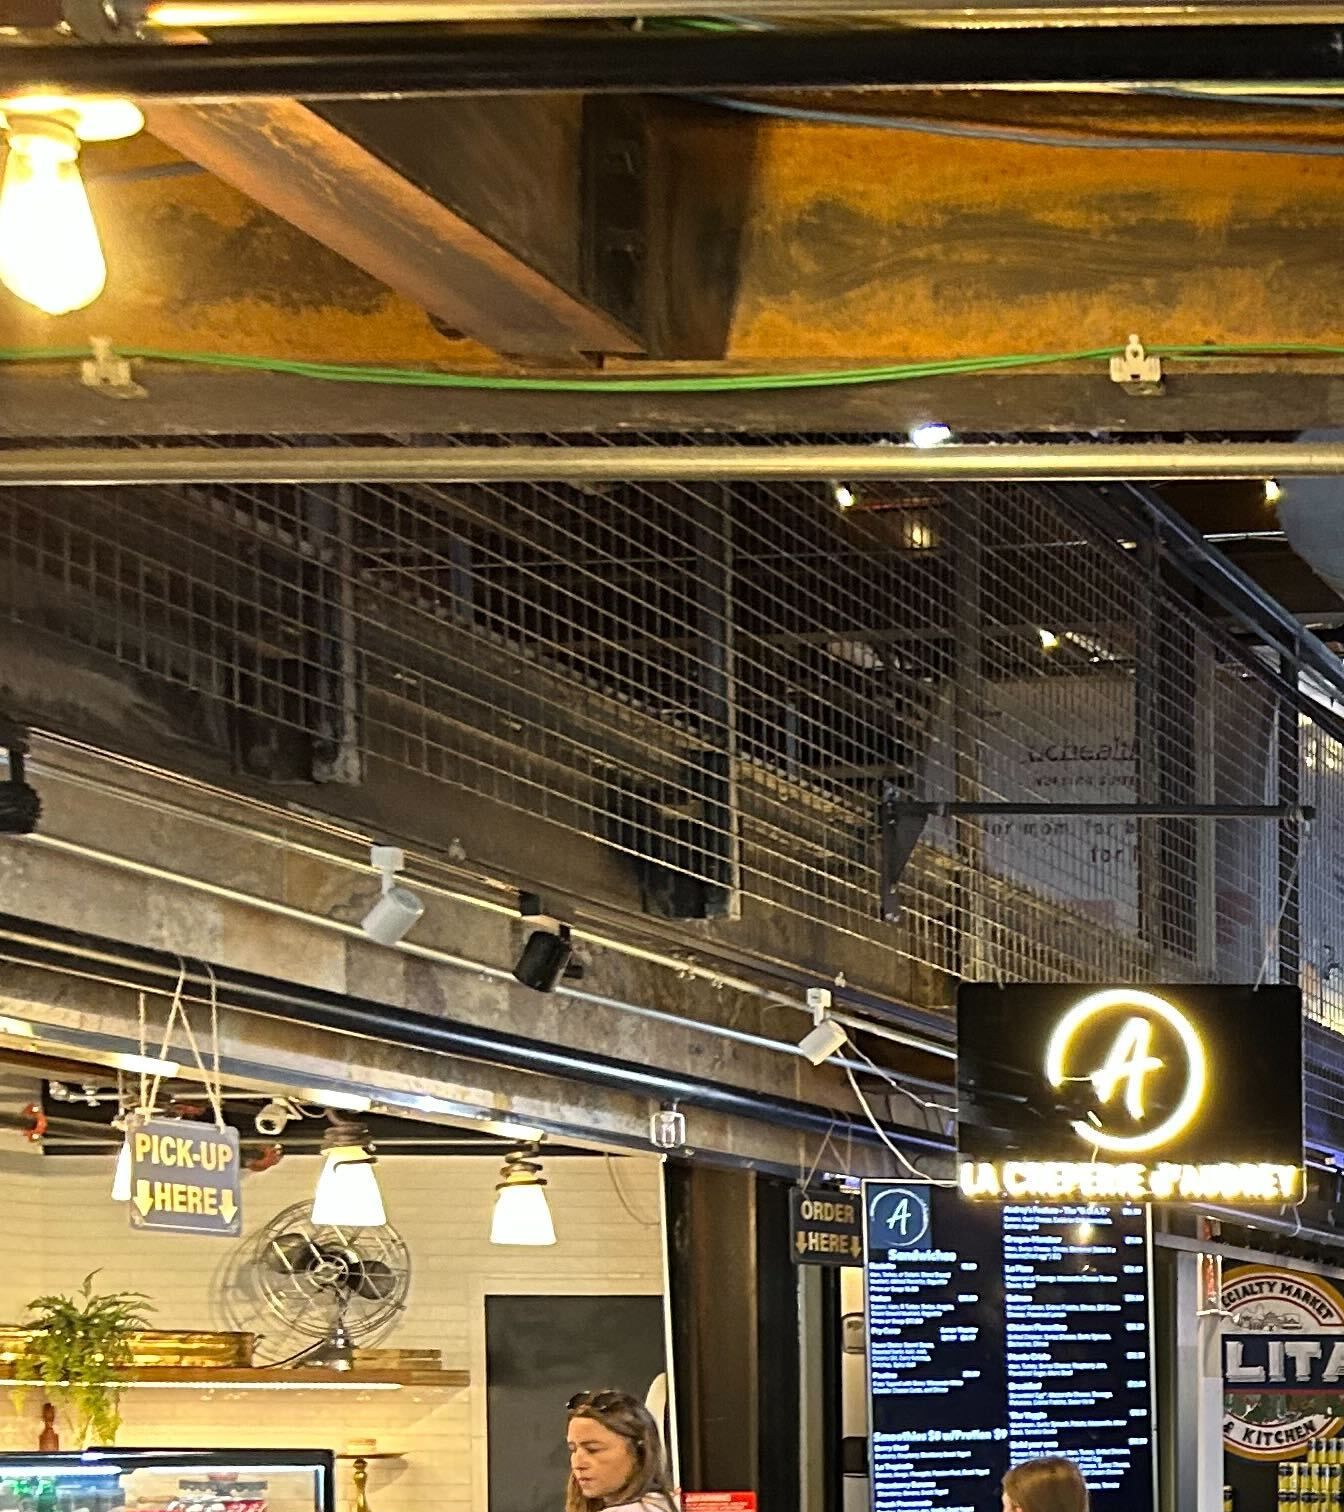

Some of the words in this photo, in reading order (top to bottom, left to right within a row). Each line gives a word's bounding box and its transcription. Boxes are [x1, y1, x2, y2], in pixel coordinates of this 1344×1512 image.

[1090, 1017, 1166, 1120] A
[134, 1132, 233, 1172] PICK-UP
[960, 1161, 1001, 1198] LA
[154, 1181, 219, 1216] HERE
[801, 1200, 855, 1224] ORDER
[807, 1231, 849, 1253] HERE
[887, 1248, 957, 1262] Sandwiches
[1222, 1281, 1275, 1309] CIALTY
[1279, 1282, 1334, 1320] MARKET
[1242, 1419, 1318, 1447] KITCHEN
